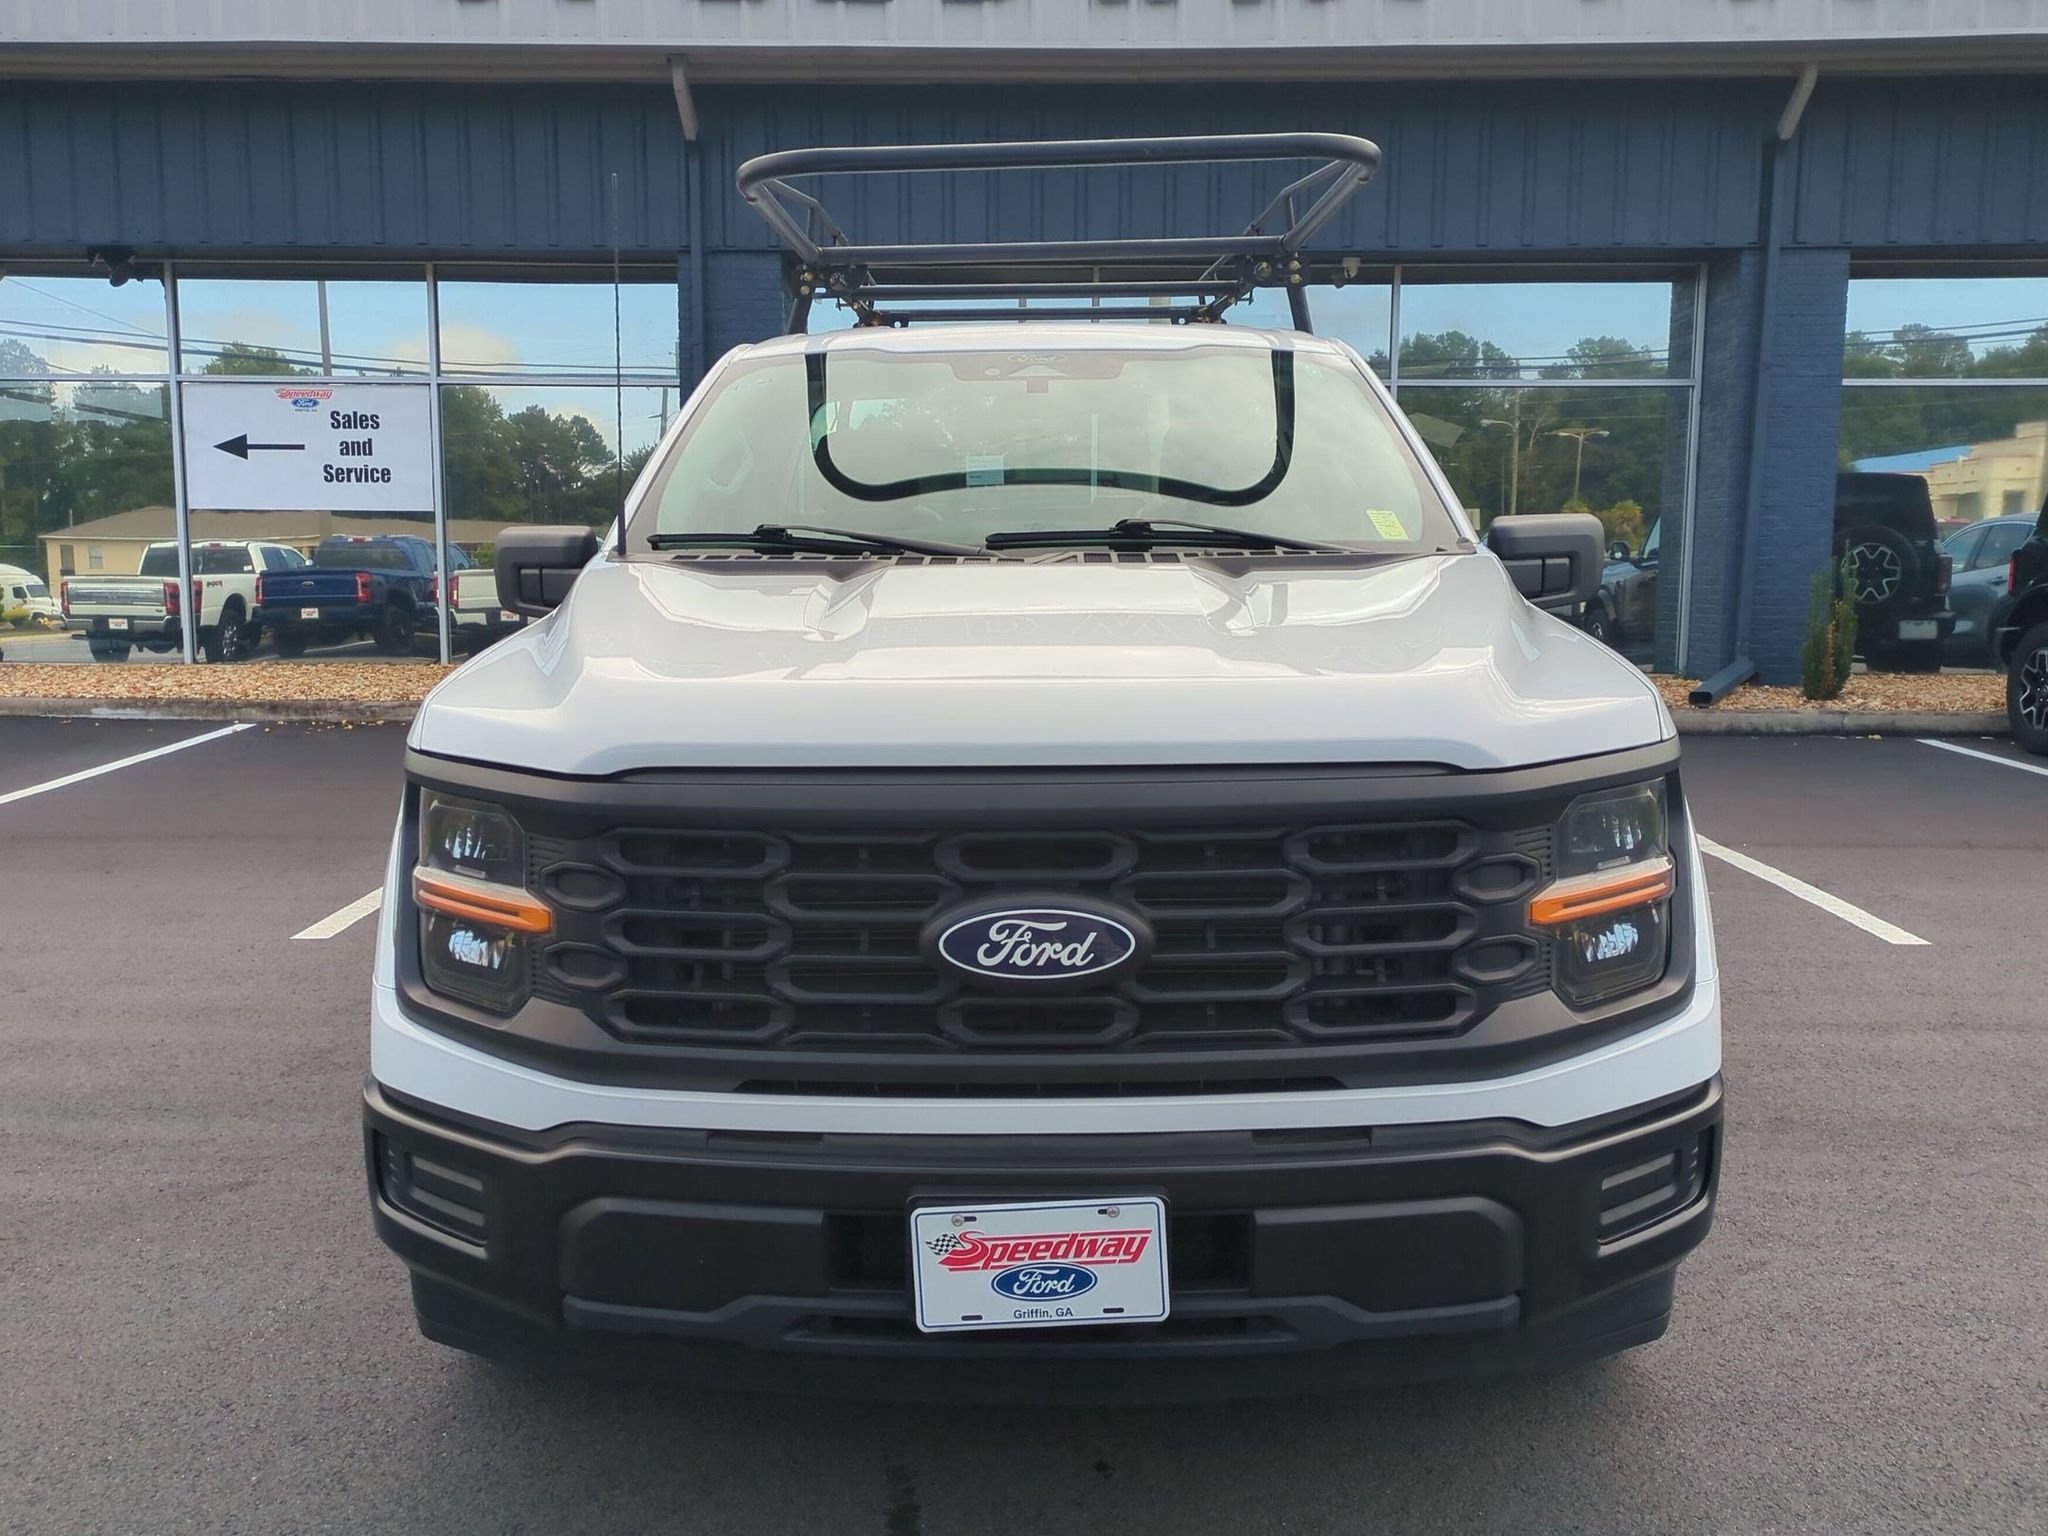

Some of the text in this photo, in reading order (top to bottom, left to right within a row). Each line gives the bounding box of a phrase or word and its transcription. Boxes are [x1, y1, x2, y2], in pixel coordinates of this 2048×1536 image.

[278, 388, 333, 399] Speedway
[330, 410, 380, 430] Sales
[339, 438, 373, 456] and
[323, 464, 391, 483] Service
[977, 919, 1097, 966] Ford
[938, 1230, 1152, 1271] Speedway
[1013, 1268, 1075, 1295] Ford
[1013, 1307, 1074, 1320] Griffin, GA
